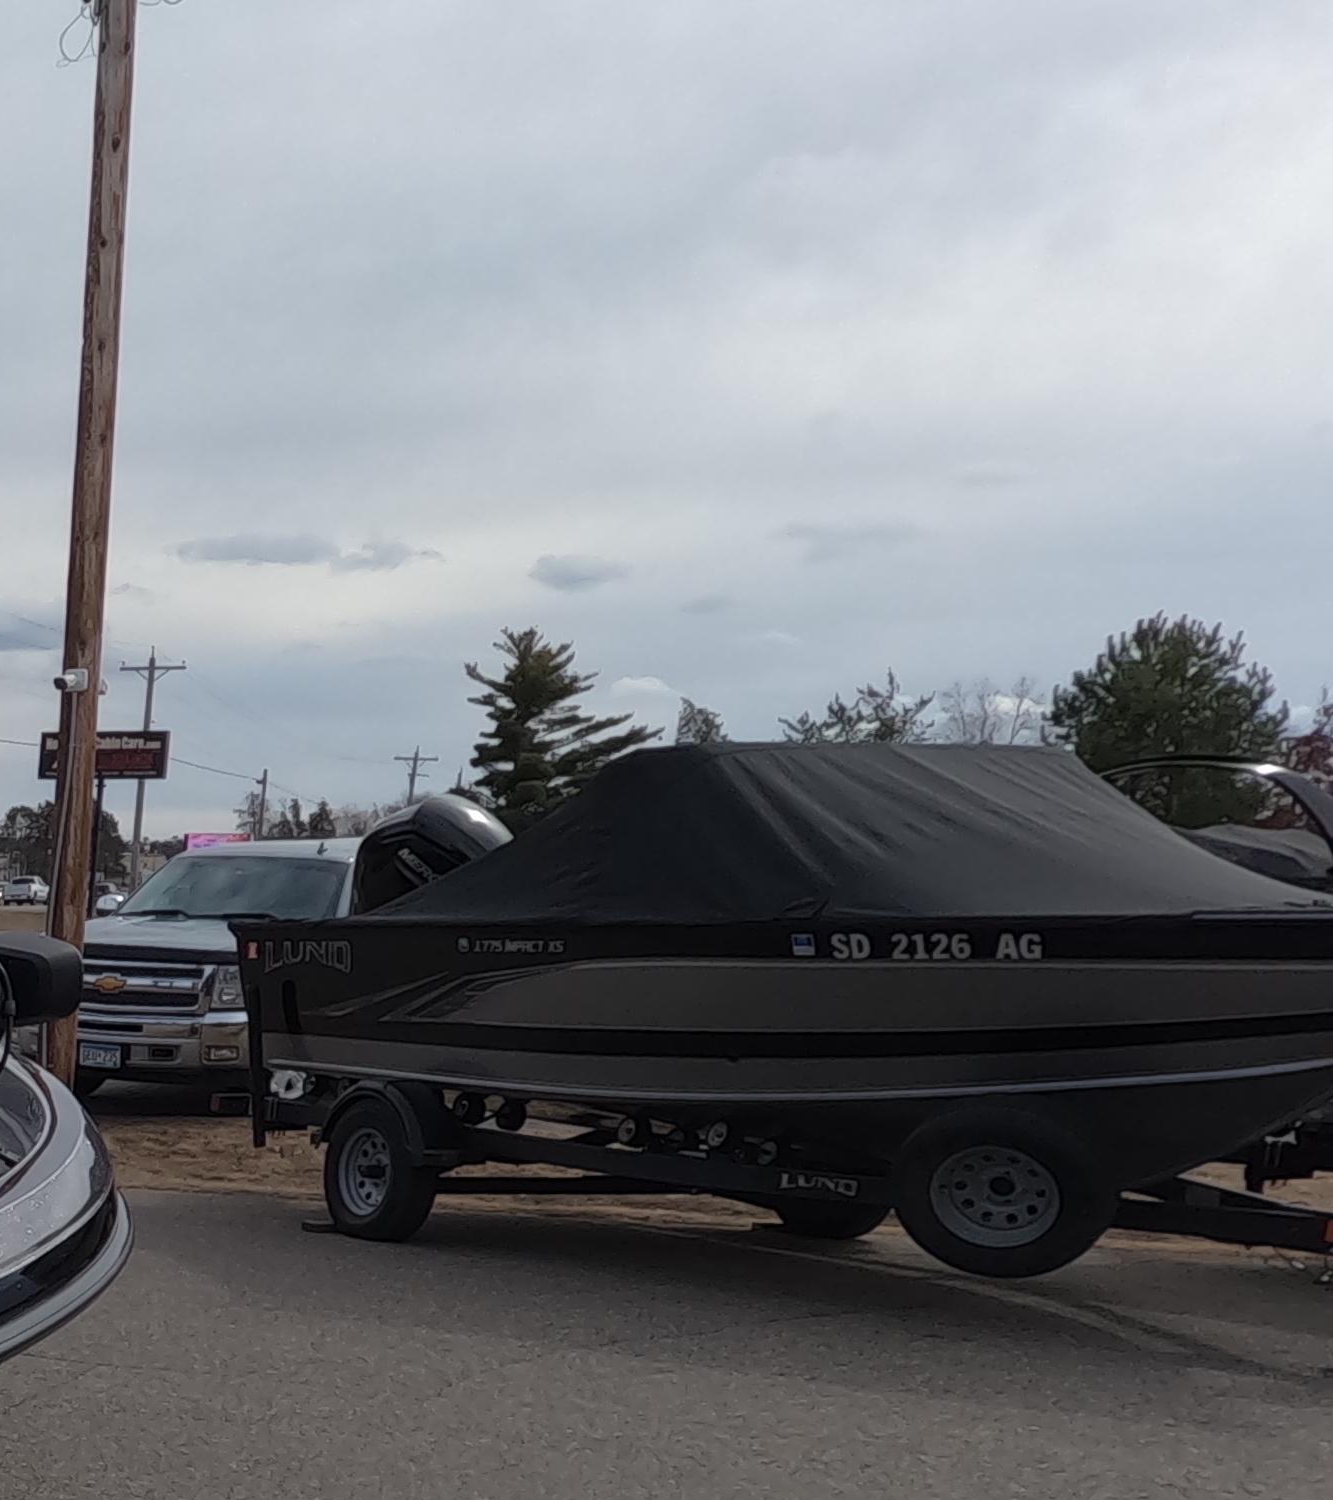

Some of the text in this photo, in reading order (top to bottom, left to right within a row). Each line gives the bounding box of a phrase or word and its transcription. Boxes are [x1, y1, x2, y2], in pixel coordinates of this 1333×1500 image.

[264, 941, 351, 974] LUND
[830, 933, 1042, 960] SD 2126 AG
[779, 1172, 858, 1196] LUND
